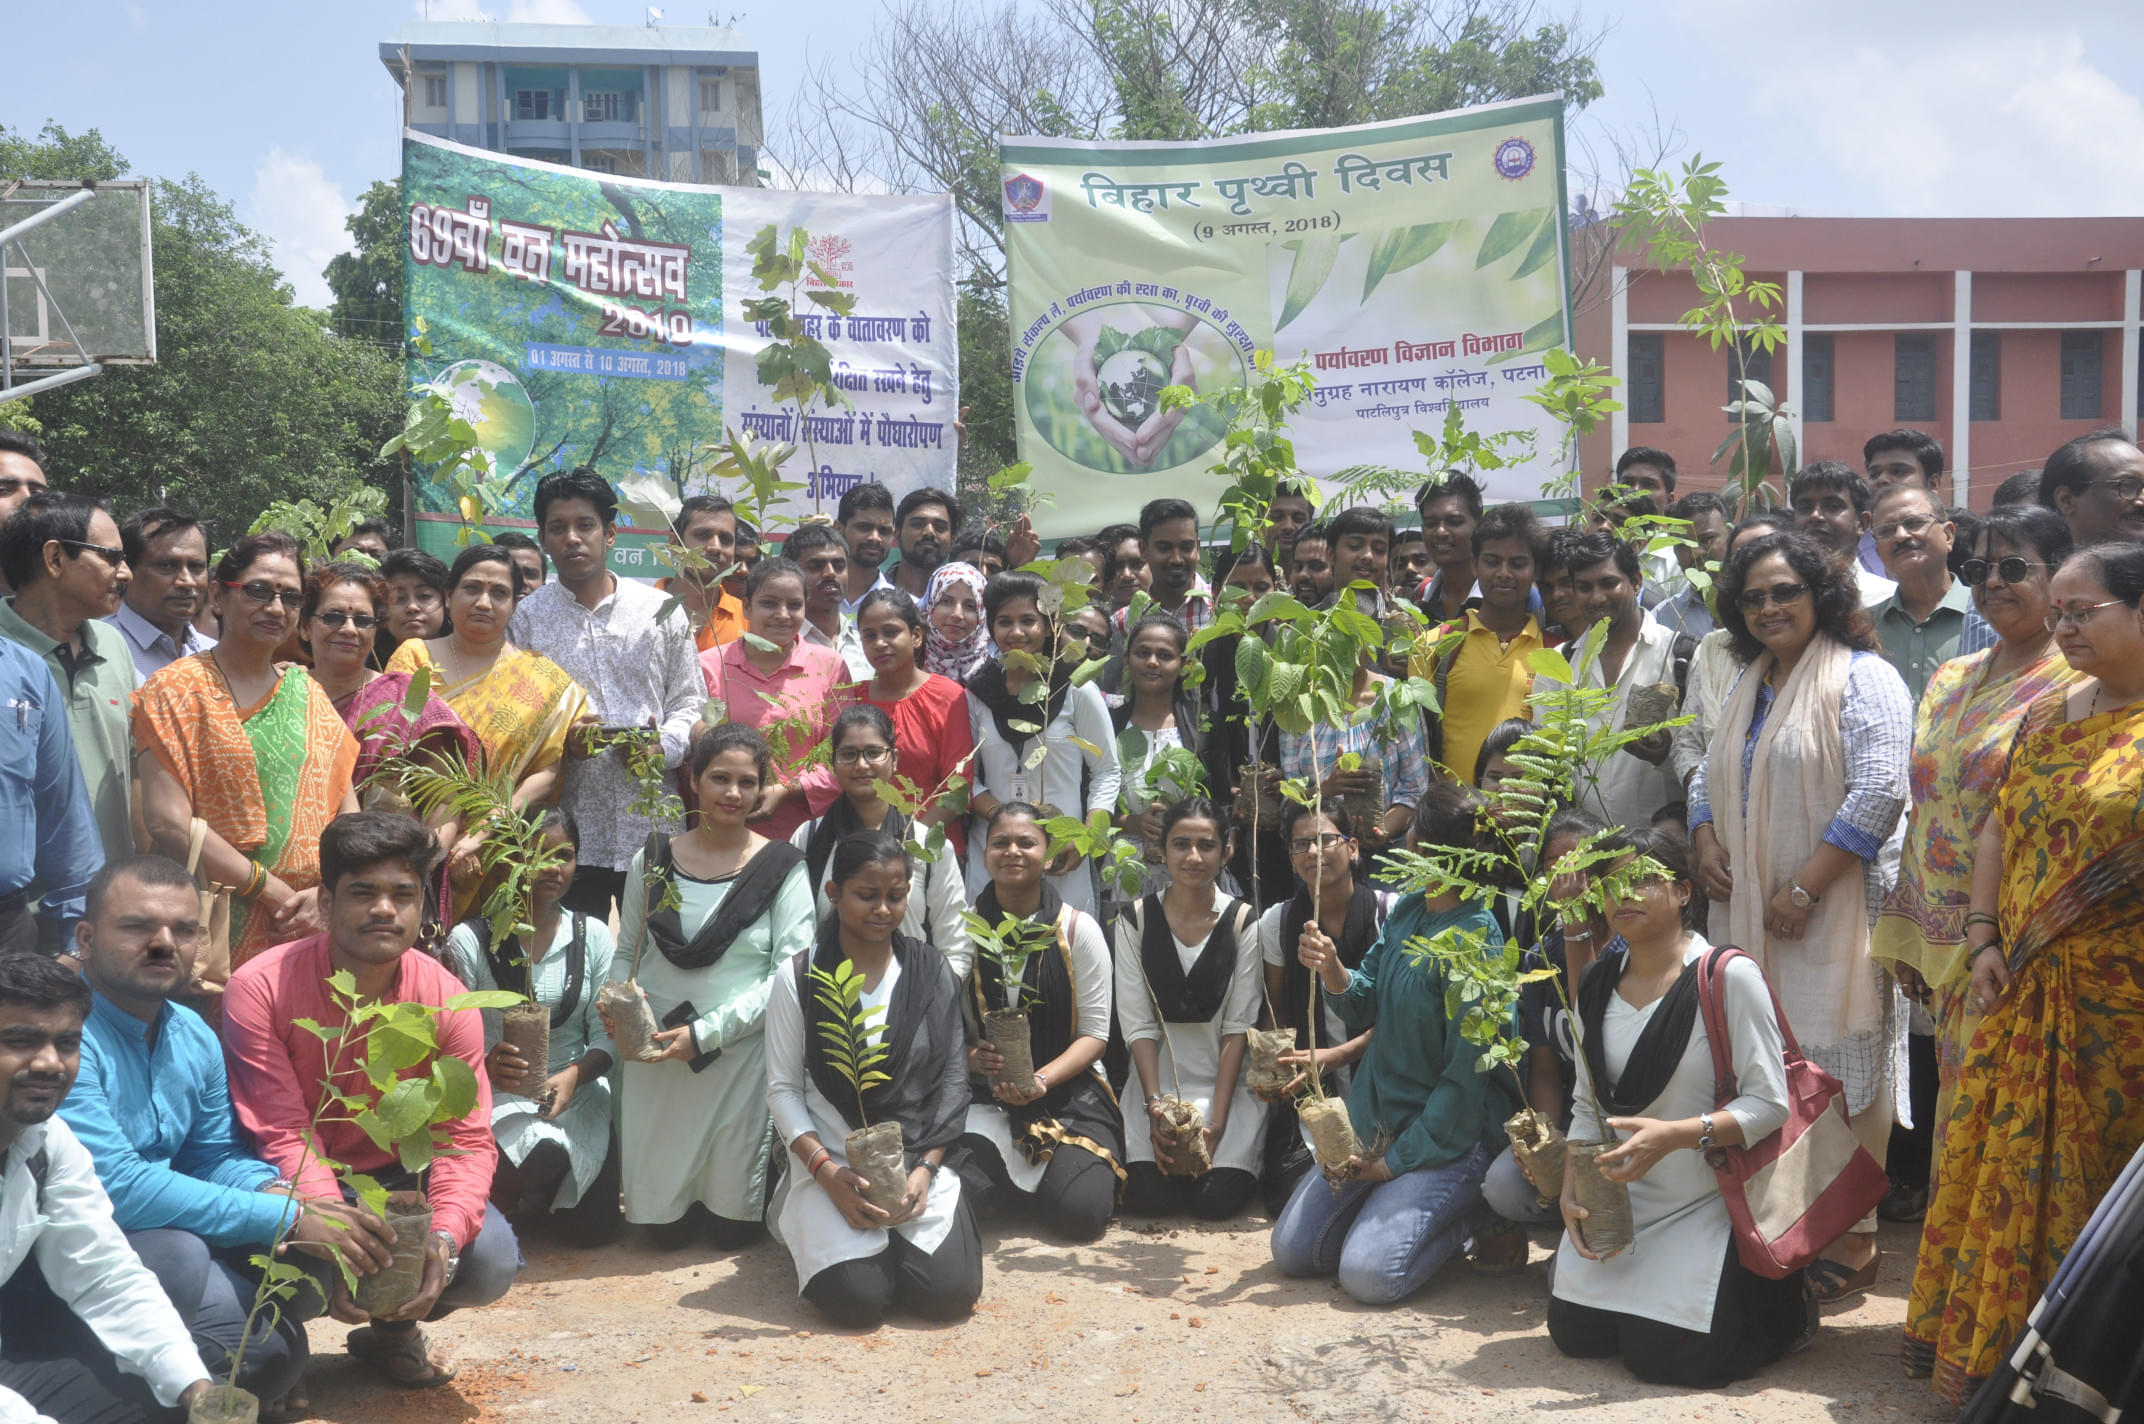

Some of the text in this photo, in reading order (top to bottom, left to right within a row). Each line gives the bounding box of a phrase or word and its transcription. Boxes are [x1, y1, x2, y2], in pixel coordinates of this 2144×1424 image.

[1080, 172, 1201, 214] बिहार
[1214, 161, 1318, 216] पृथ्वी
[1334, 152, 1453, 194] दिवस
[1285, 209, 1342, 235] 2018)
[409, 196, 691, 303] 69वाँ वन महोत्सव
[846, 315, 907, 343] वातावरण
[910, 310, 931, 344] को
[1022, 313, 1051, 348] संकल्प
[1066, 287, 1113, 308] पर्यावरण
[1115, 279, 1132, 296] की
[1135, 283, 1160, 297] रक्षा
[1184, 293, 1212, 311] पृथ्वी
[1211, 306, 1229, 324] की
[531, 349, 545, 366] 01
[550, 349, 581, 369] अगस्त
[584, 349, 594, 370] से
[600, 355, 613, 371] 10
[656, 359, 686, 377] 2018
[1314, 331, 1523, 372] पर्यावरण विज्ञान विभाग
[1358, 377, 1428, 397] नारायण
[1501, 364, 1546, 383] पटना
[1355, 403, 1410, 421] पाटलिपुत्र
[613, 547, 646, 566] वन
